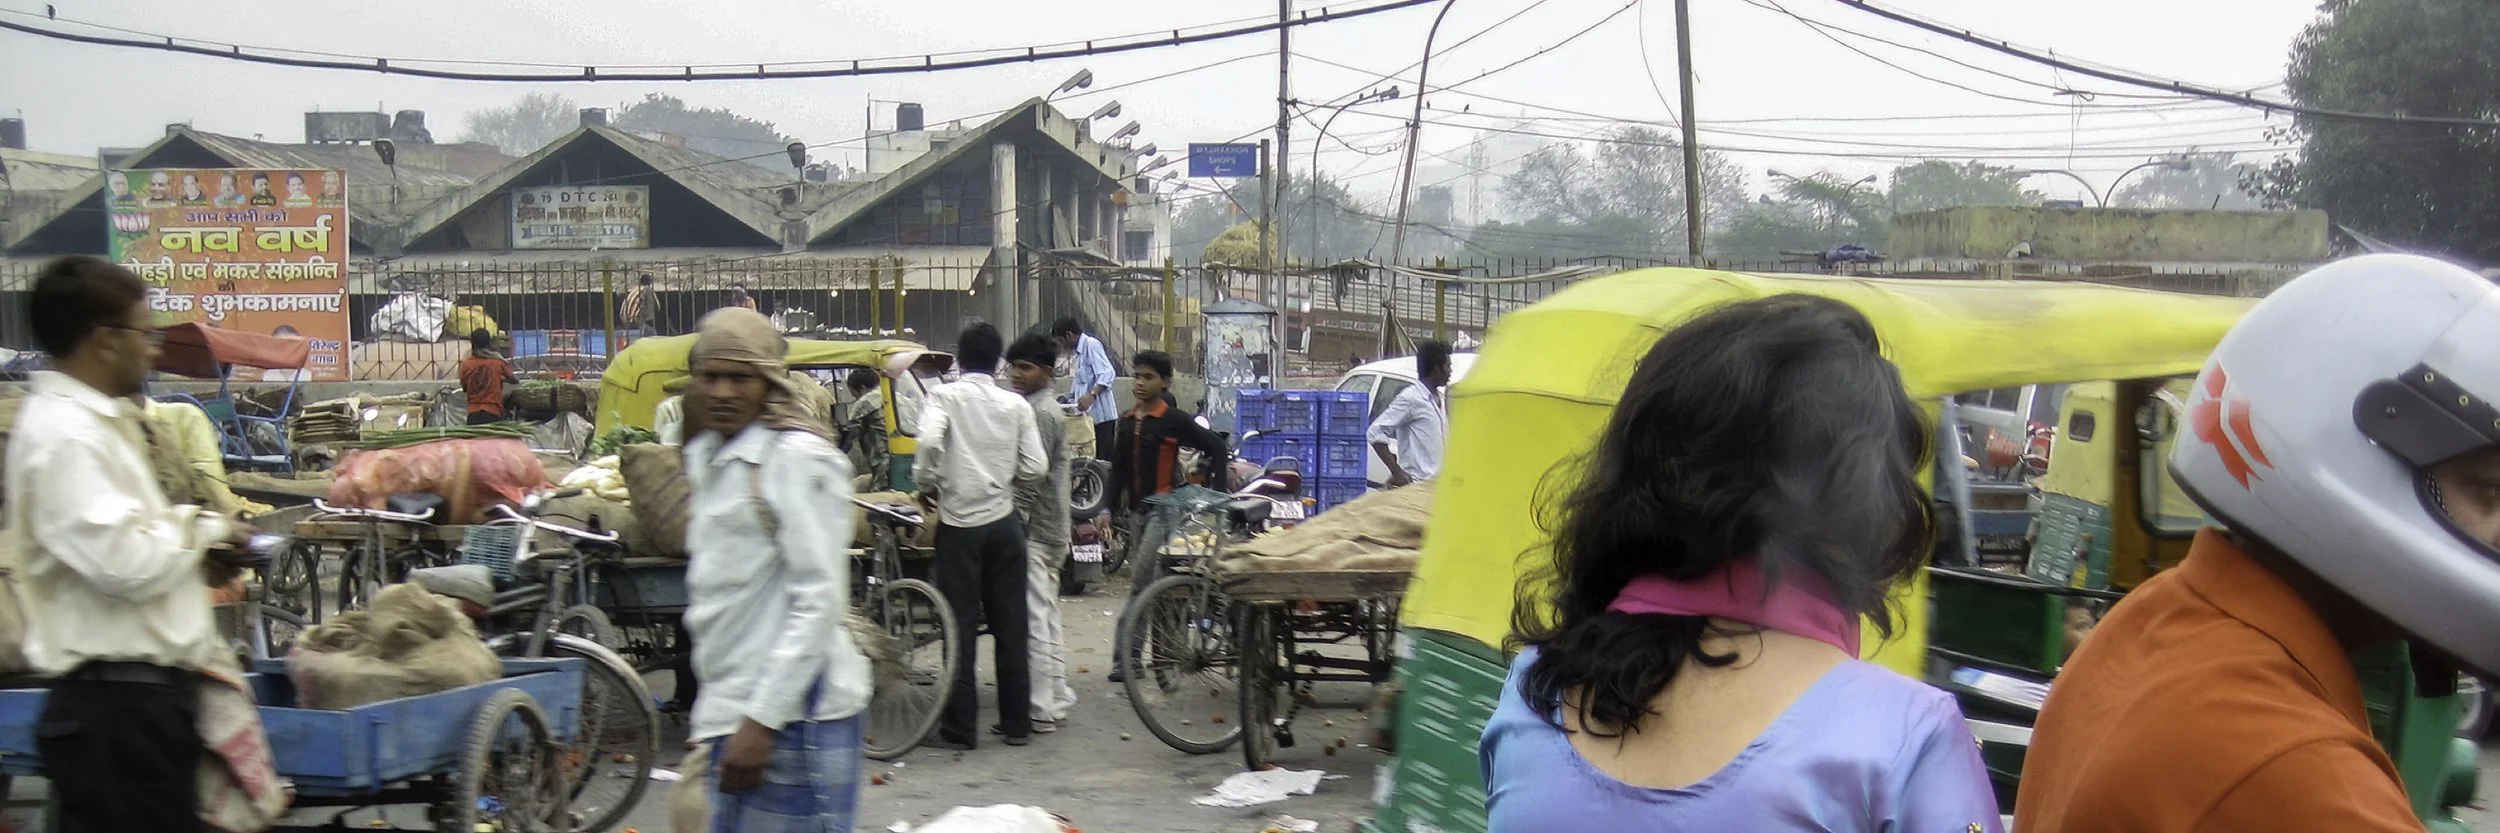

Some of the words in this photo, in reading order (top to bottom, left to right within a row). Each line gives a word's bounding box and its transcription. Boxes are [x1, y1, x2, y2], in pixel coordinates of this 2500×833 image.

[159, 226, 243, 253] नव
[254, 214, 333, 253] वर्ष
[116, 255, 176, 287] ोहड़ी
[180, 256, 211, 280] एवं
[212, 262, 262, 281] मकर
[264, 255, 339, 283] संक्रान्ति
[201, 287, 346, 321] शुभकामनाएं
